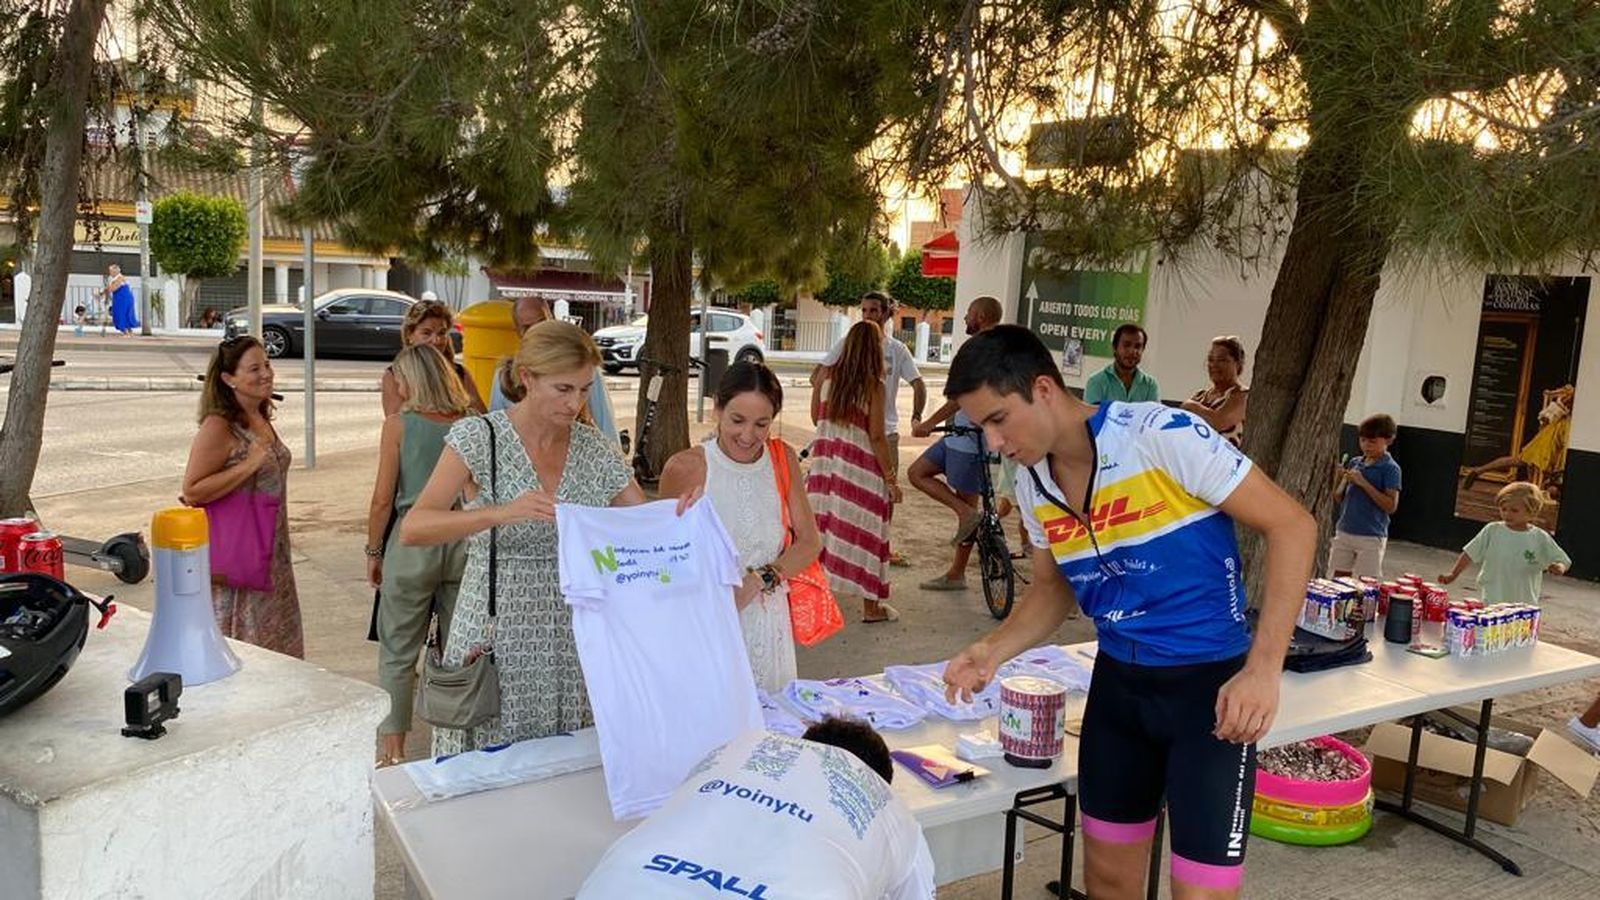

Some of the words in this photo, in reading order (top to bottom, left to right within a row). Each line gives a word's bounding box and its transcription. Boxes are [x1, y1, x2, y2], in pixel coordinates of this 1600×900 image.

[1039, 301, 1071, 315] ABIERTO
[1073, 303, 1099, 318] TODOS
[1101, 306, 1118, 320] LOS
[1119, 304, 1140, 322] DÍAS
[1040, 323, 1068, 337] OPEN
[1071, 326, 1108, 342] EVERY
[1043, 496, 1142, 545] DHL
[700, 779, 814, 824] @yoinytu
[643, 854, 774, 900] SPALL
